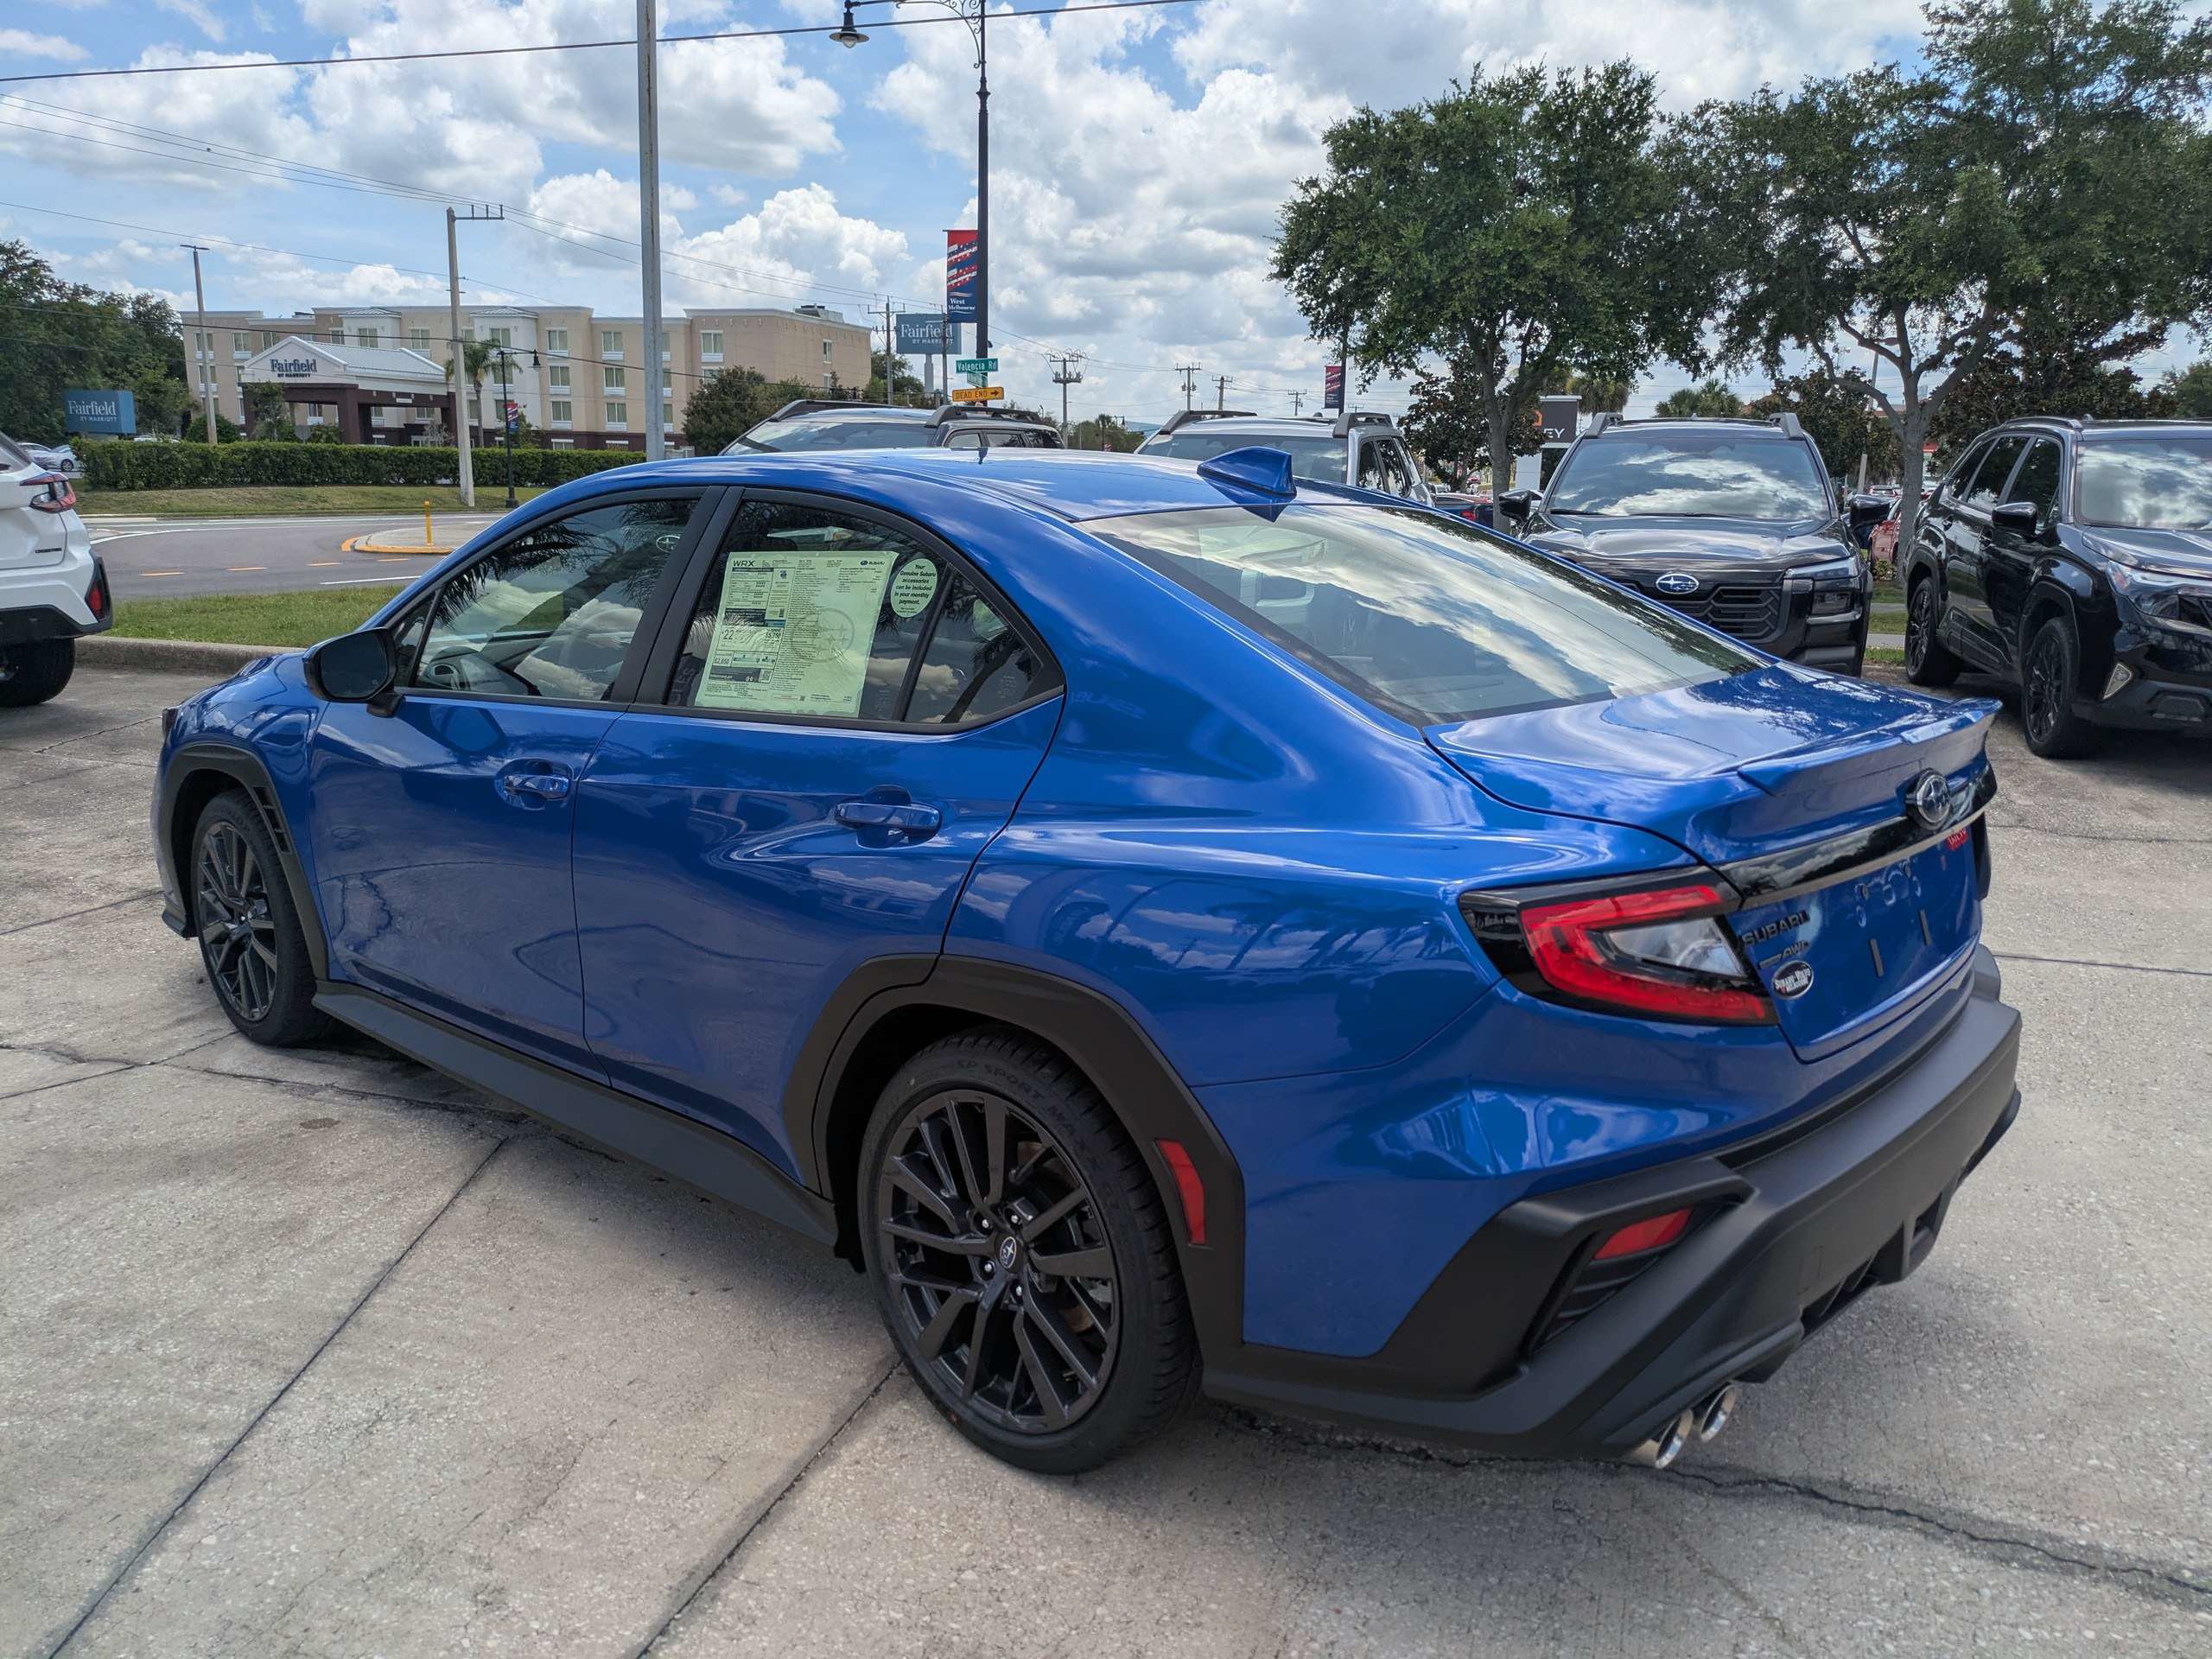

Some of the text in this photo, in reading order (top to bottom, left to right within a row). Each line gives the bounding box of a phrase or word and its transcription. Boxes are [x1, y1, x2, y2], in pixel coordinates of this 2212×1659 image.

[900, 323, 953, 339] Fairfied
[270, 359, 318, 372] Fairfield
[957, 360, 996, 372] Valencia Rd
[956, 390, 988, 400] DEAD END
[68, 400, 118, 416] Fairfield
[722, 629, 734, 639] 22
[1742, 910, 1810, 945] SUBARU
[1783, 939, 1811, 957] AWD
